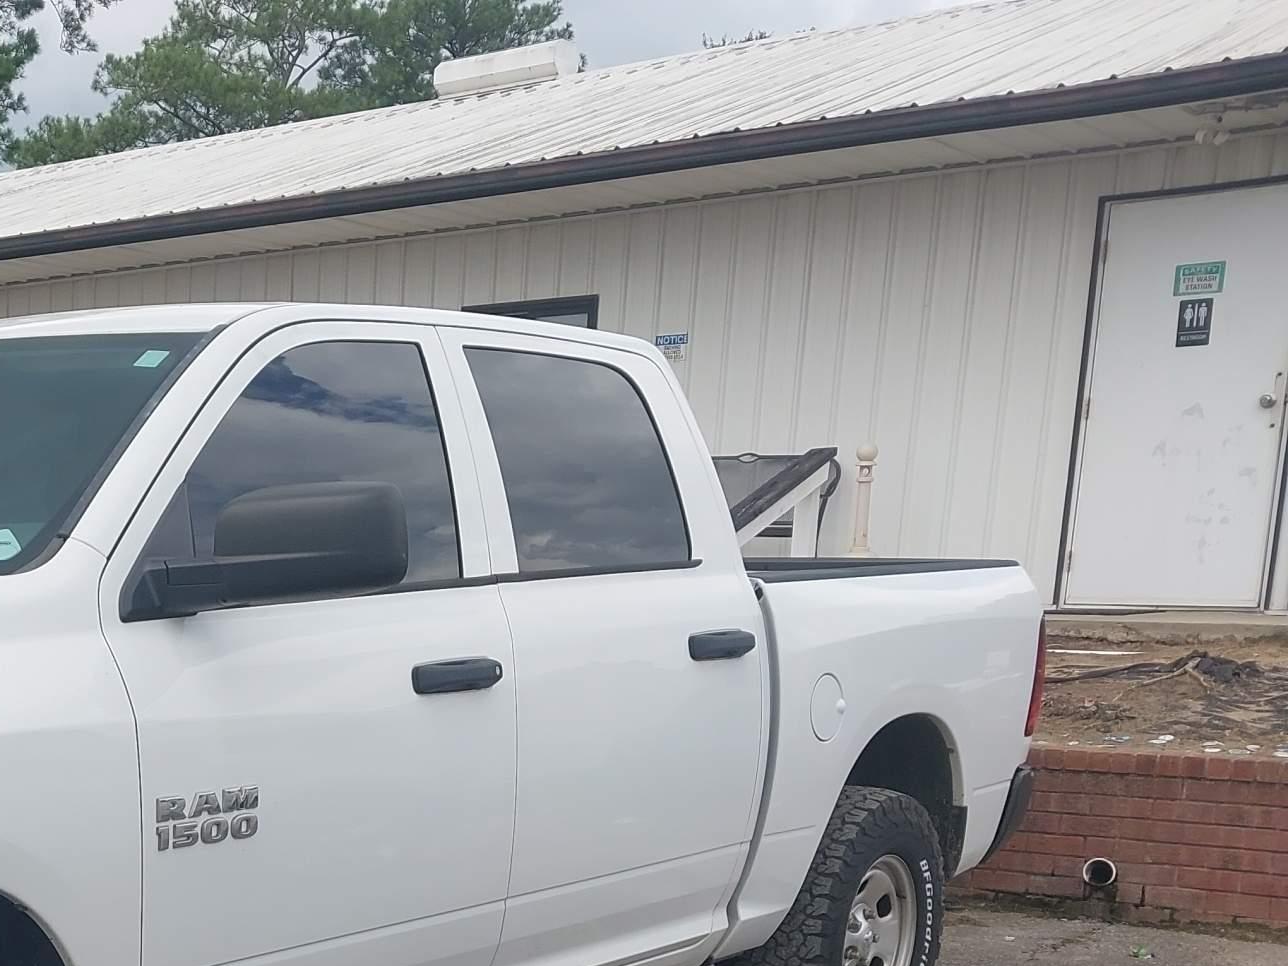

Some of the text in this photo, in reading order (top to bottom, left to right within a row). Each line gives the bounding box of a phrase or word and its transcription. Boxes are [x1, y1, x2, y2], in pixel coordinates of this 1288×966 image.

[1183, 276, 1194, 284] EYE
[657, 335, 687, 345] NOTICE
[156, 784, 259, 823] RAM
[156, 812, 259, 852] 1500
